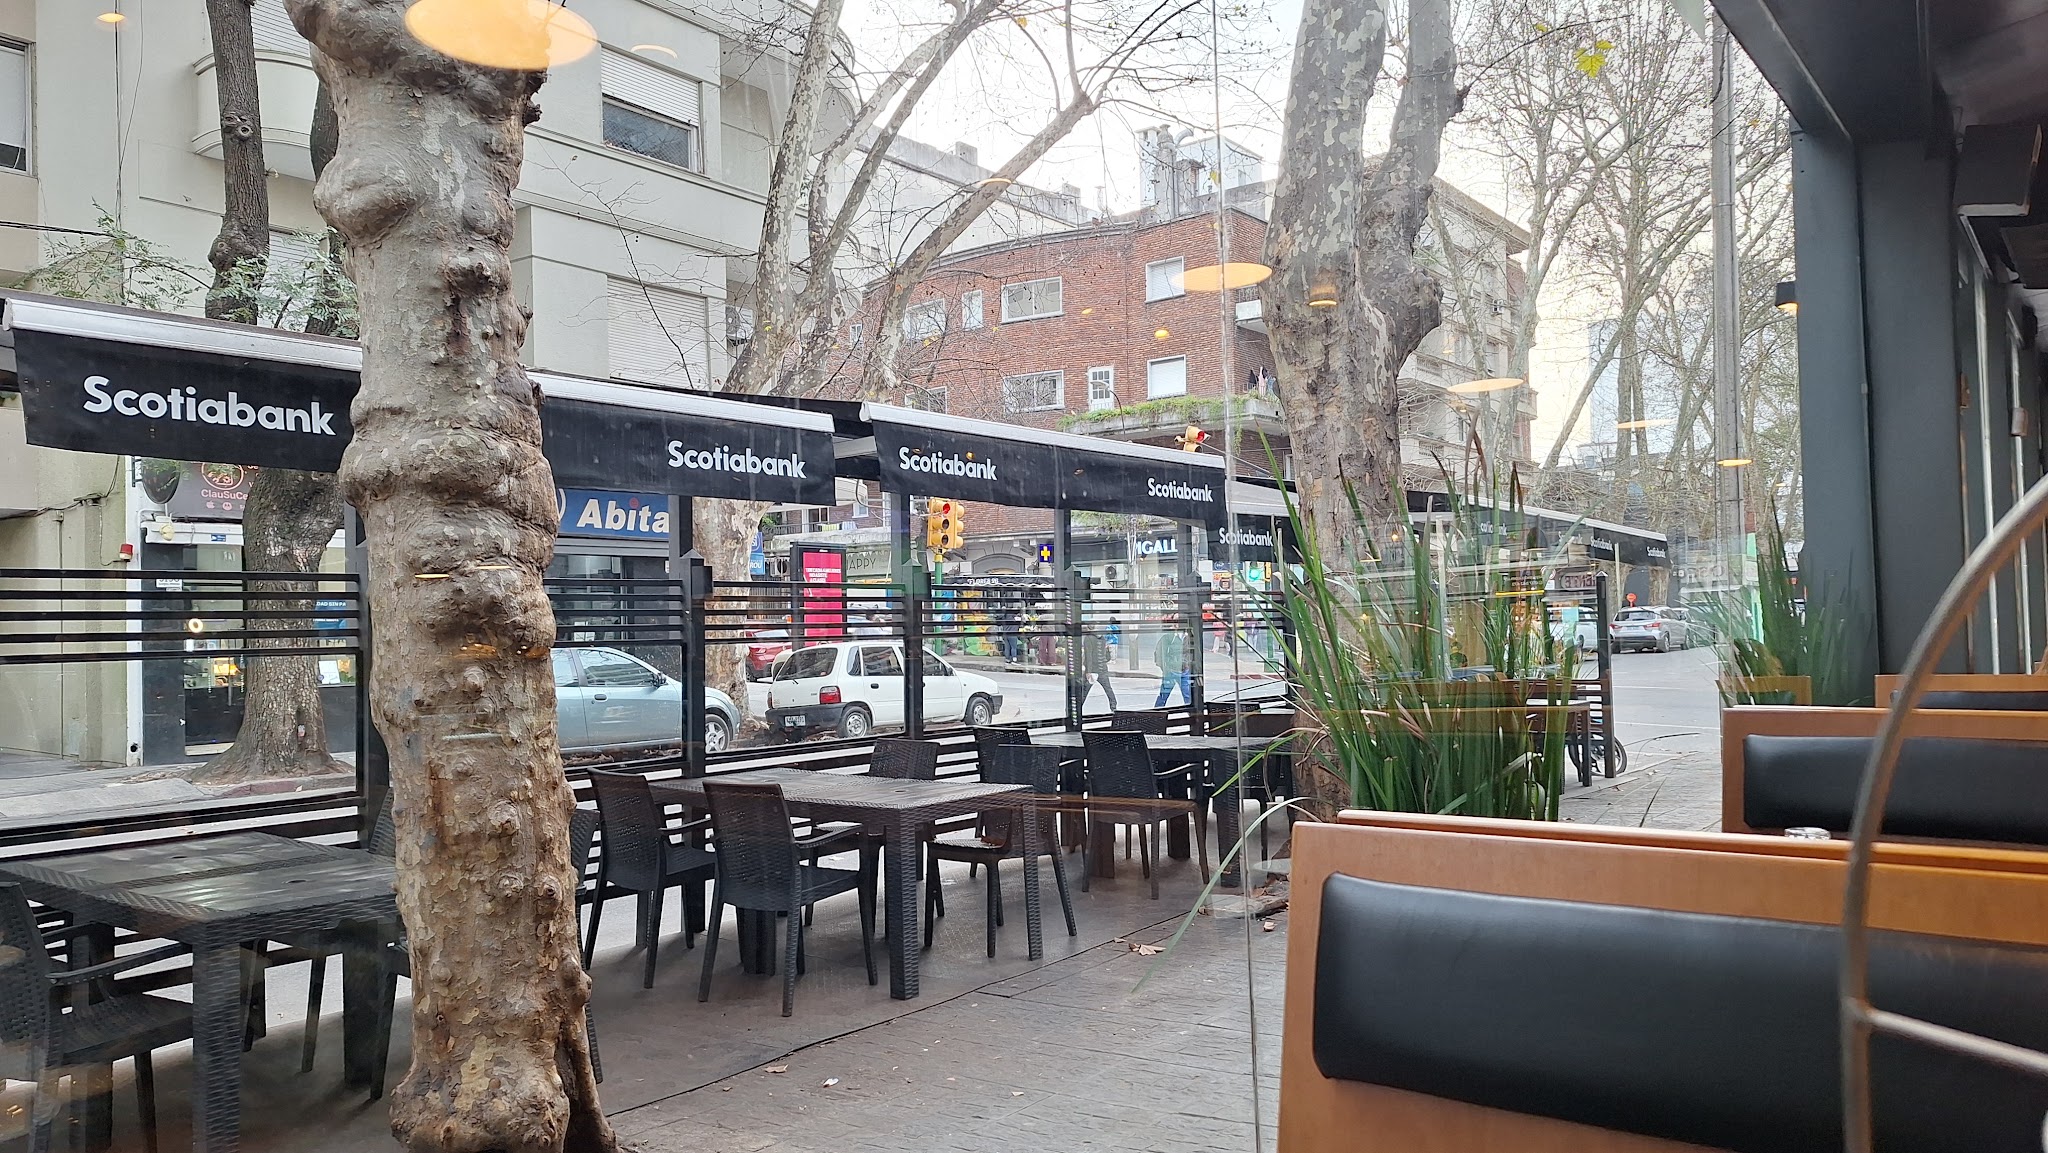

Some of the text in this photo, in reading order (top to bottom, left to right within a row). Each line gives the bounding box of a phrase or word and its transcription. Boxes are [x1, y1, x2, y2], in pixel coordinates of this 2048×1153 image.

[83, 375, 336, 436] Scotiabank
[668, 440, 807, 479] Scotiabank
[899, 447, 997, 480] Scotiabank
[1147, 478, 1213, 502] Scotiabank
[577, 498, 669, 533] Abita
[1219, 527, 1275, 547] Scotiabank
